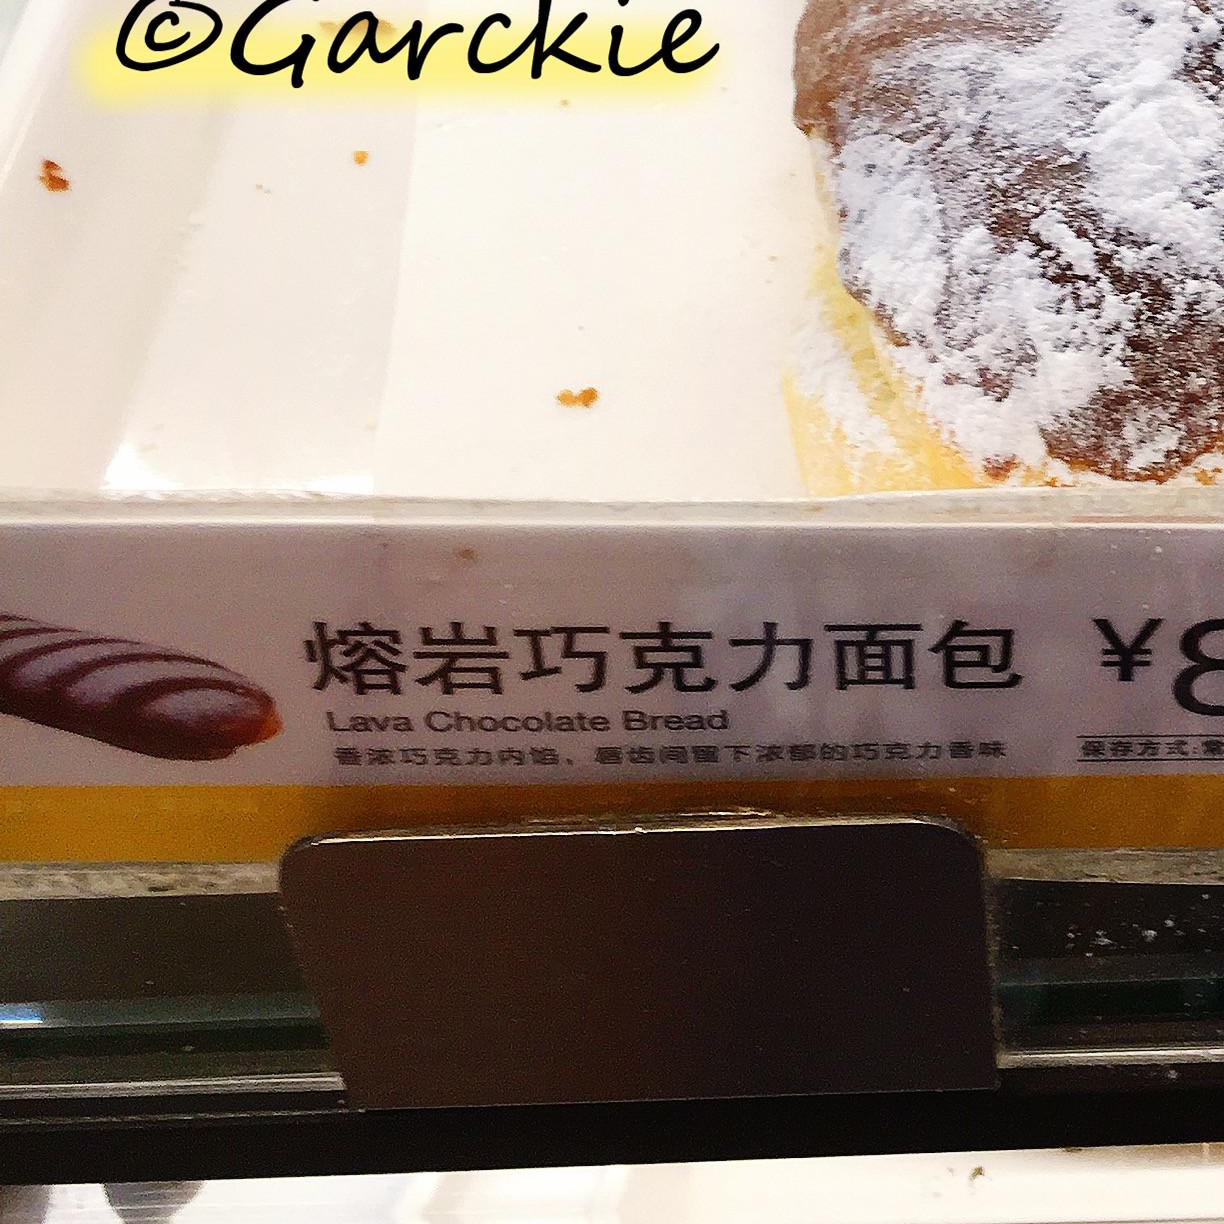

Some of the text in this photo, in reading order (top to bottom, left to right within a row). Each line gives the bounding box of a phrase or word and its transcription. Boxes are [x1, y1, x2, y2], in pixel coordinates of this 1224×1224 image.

[304, 619, 1024, 696] 熔岩巧克力面包
[326, 709, 730, 733] Lava Chocolate Bread
